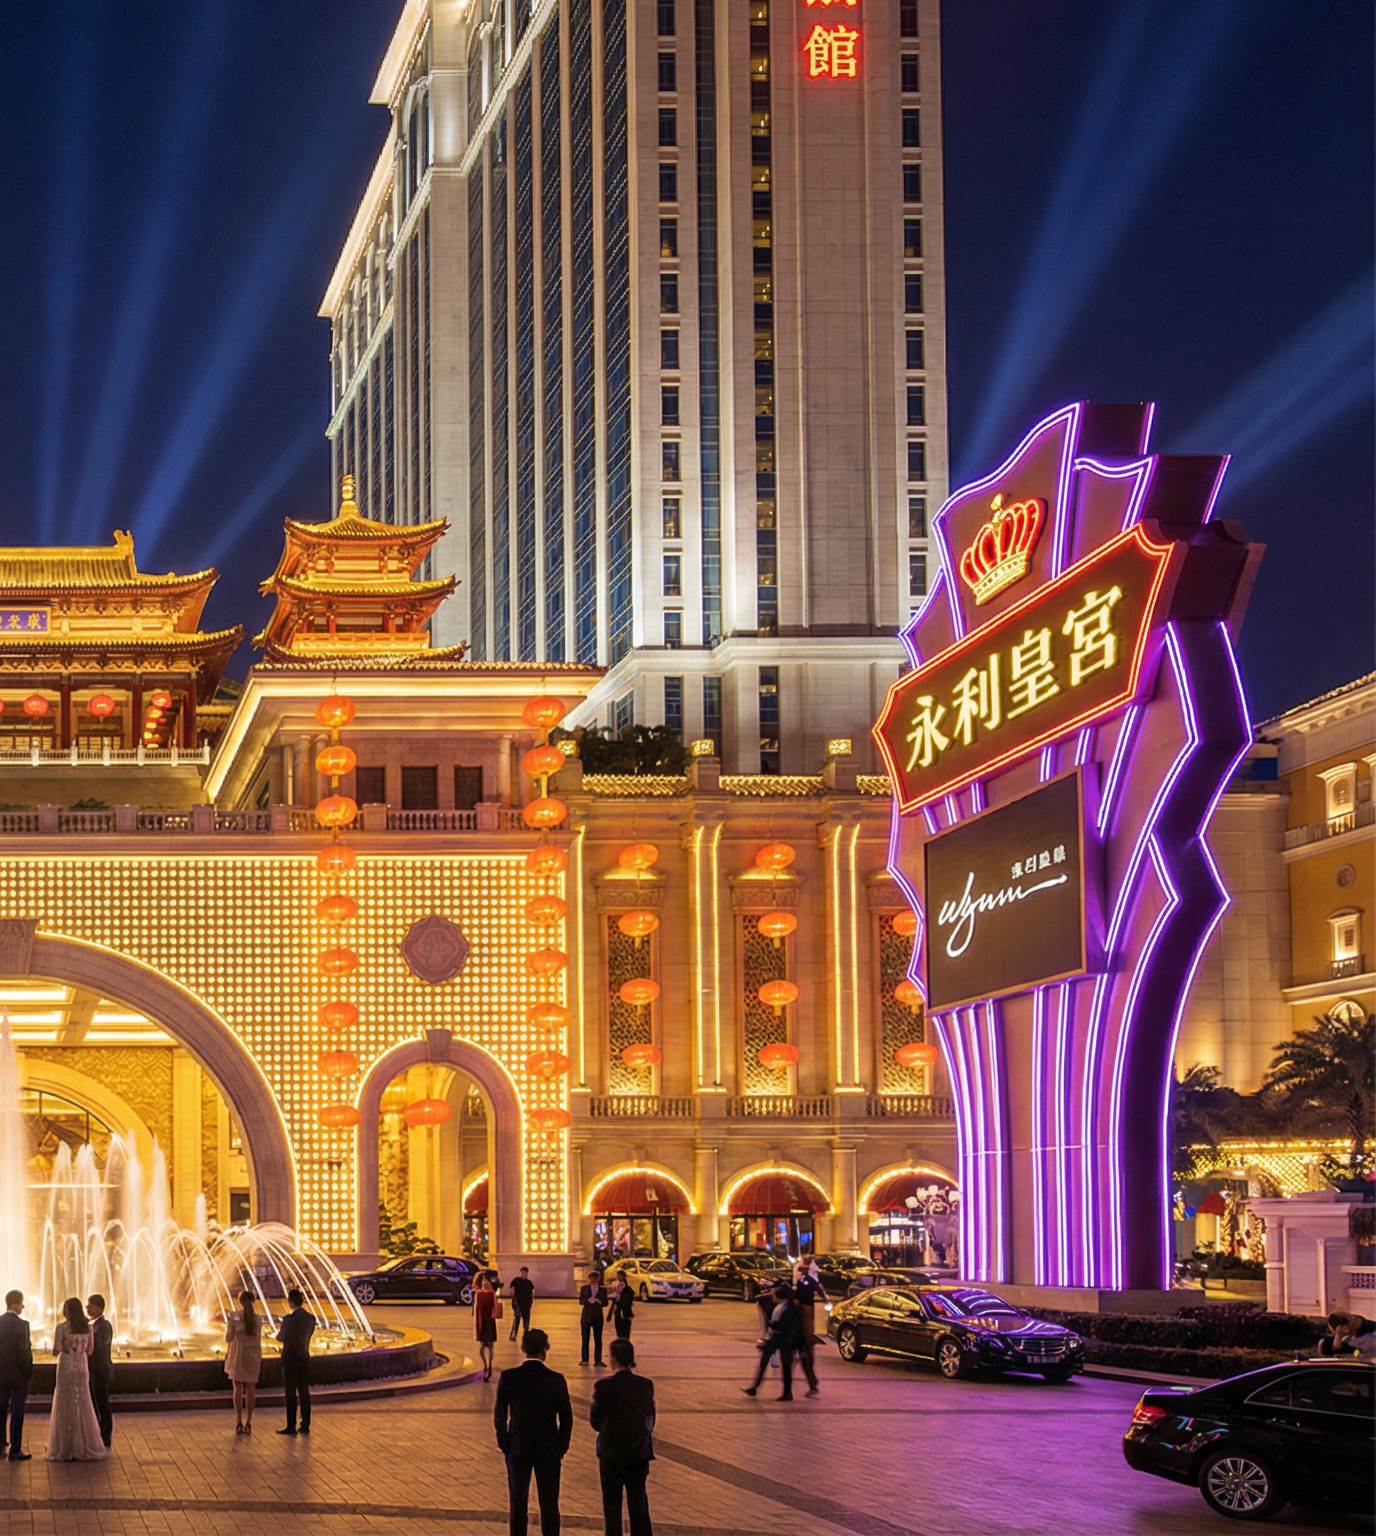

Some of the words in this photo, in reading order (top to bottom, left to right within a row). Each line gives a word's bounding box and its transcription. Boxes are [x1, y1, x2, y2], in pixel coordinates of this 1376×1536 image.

[804, 0, 859, 77] 館
[905, 585, 1123, 773] 永利皇宮
